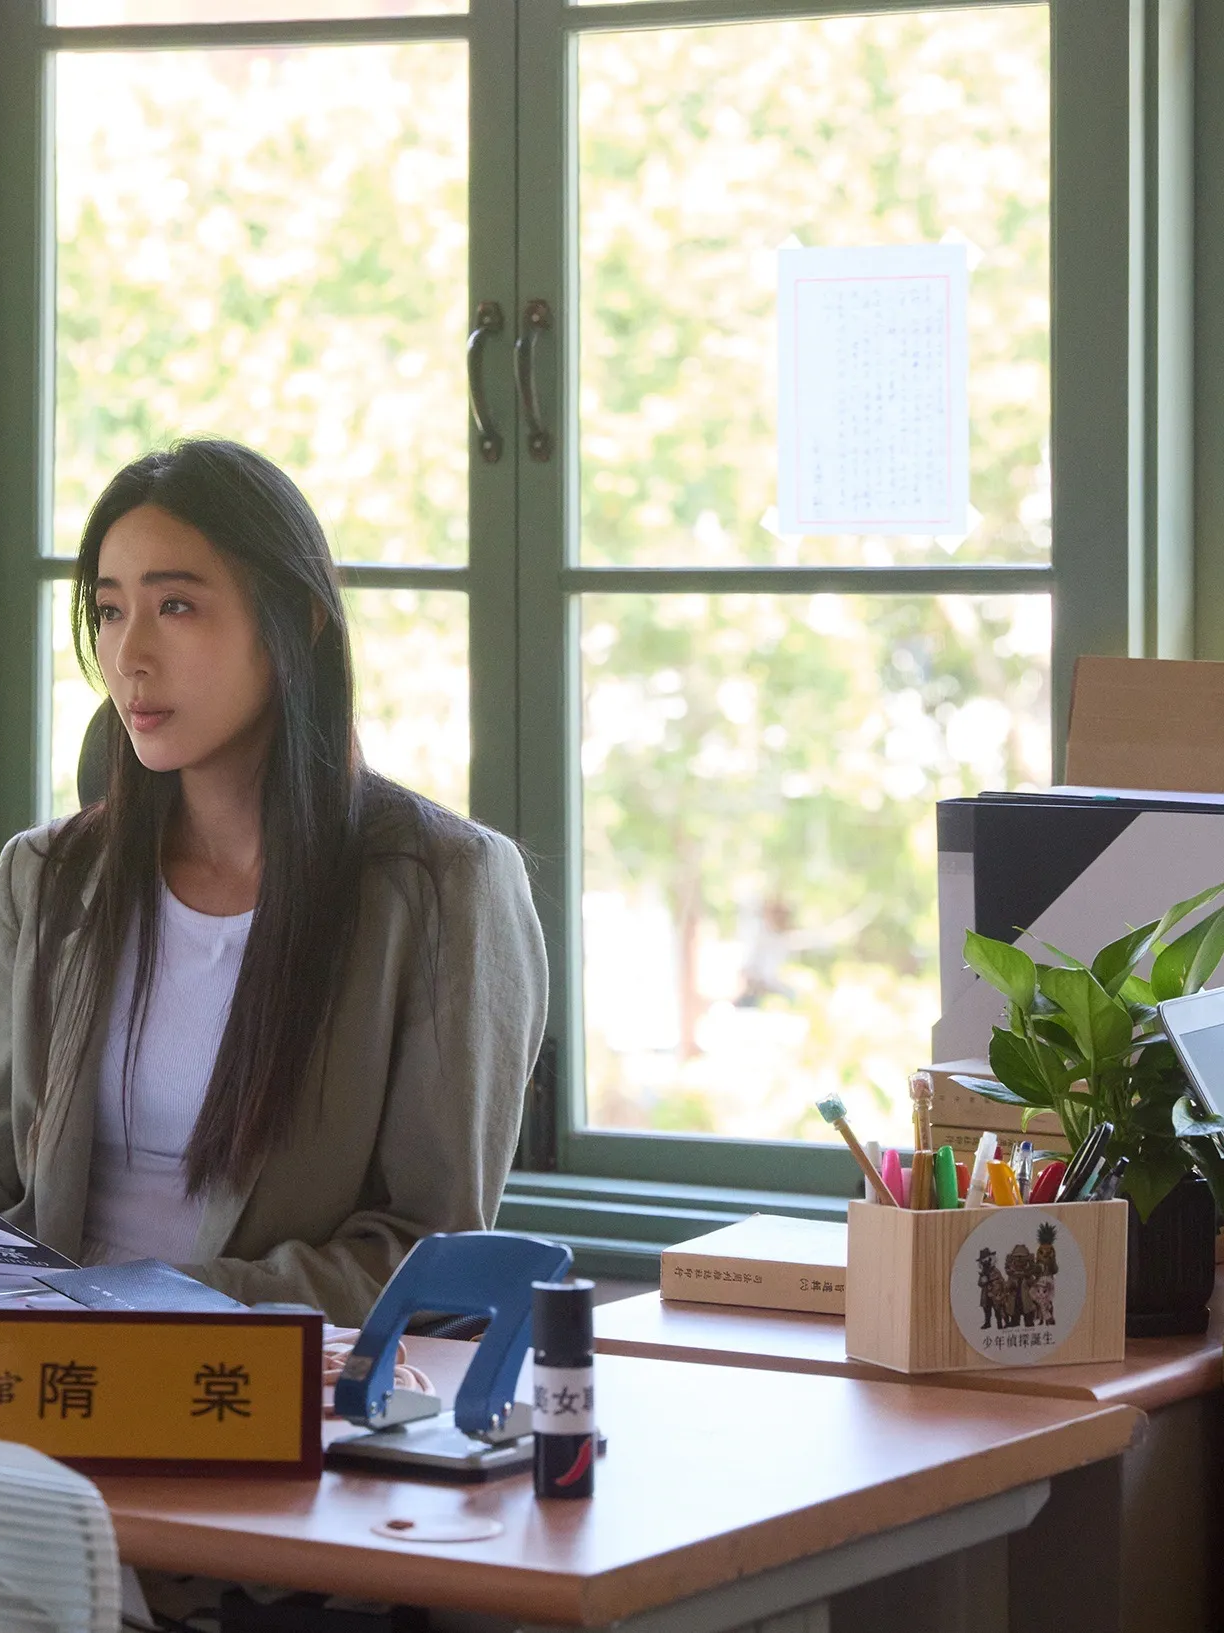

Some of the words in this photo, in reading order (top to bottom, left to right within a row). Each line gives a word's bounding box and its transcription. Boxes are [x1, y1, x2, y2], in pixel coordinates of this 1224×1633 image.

[982, 1331, 1056, 1351] 少年偵探誕生
